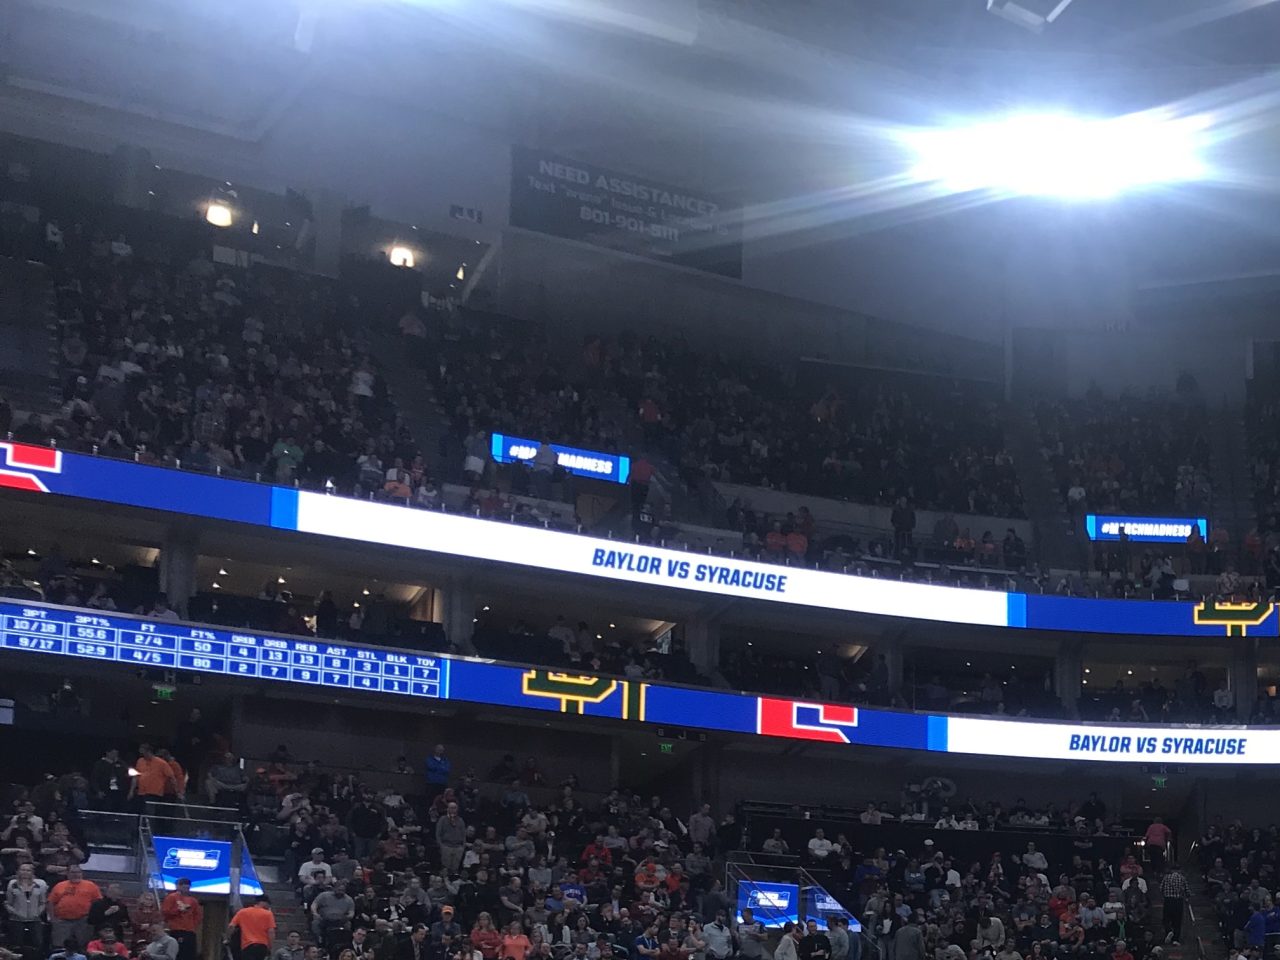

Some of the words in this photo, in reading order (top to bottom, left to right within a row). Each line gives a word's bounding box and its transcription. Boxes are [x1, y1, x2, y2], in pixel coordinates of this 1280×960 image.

[539, 160, 590, 185] NEED
[595, 174, 719, 217] ASSISTANCE?
[592, 548, 662, 576] BAYLOR
[667, 559, 690, 580] VS
[694, 563, 788, 593] SYRACUSE
[23, 608, 47, 619] 3PT
[75, 615, 110, 627] 3PT%
[141, 623, 156, 633] FT
[191, 629, 216, 640] FT%
[295, 643, 317, 653] REB
[326, 646, 347, 656] AST
[357, 651, 377, 660] STL
[386, 654, 407, 664] BLK
[416, 658, 436, 667] TOV
[77, 627, 107, 640] 55.6
[194, 641, 212, 652] 50
[239, 648, 248, 657] 4
[268, 651, 282, 661] 13
[300, 655, 314, 665] 13
[363, 662, 371, 671] 3
[423, 669, 429, 678] 7
[77, 643, 107, 656] 52.9
[239, 663, 248, 672] 2
[271, 667, 279, 676] 7
[302, 670, 311, 680] 9
[333, 674, 340, 683] 7
[362, 678, 370, 687] 4
[422, 684, 428, 694] 7
[1069, 734, 1131, 753] BAYLOR
[1136, 736, 1158, 754] VS
[1161, 737, 1247, 756] SYRACUSE
